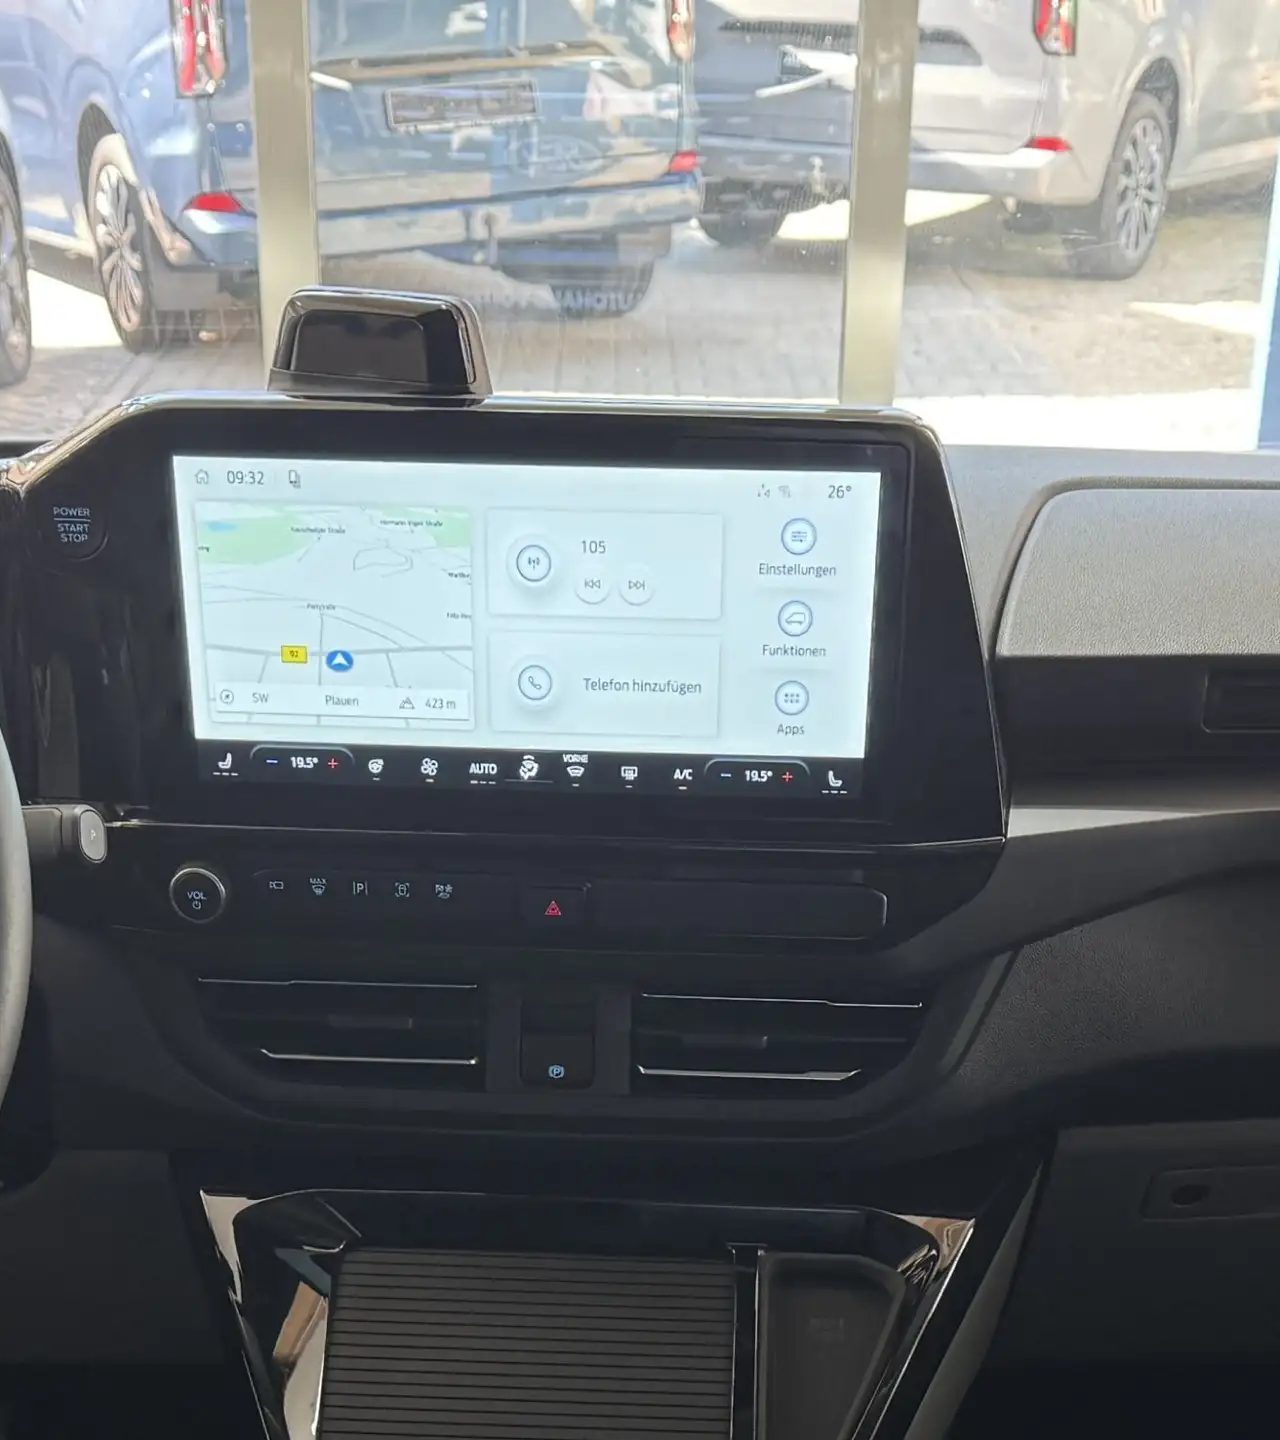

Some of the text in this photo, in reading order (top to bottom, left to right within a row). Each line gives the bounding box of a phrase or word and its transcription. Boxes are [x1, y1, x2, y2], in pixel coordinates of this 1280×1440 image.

[227, 470, 265, 485] 09:32
[827, 485, 852, 499] 26°
[53, 506, 91, 517] POWER
[57, 523, 90, 533] START
[60, 533, 88, 543] STOP
[581, 540, 607, 555] 105
[758, 562, 837, 578] Einstellungen
[762, 644, 827, 659] Funktionen
[583, 677, 702, 696] Telefon hinzufügen
[252, 692, 269, 704] SW
[325, 694, 359, 707] Plauen
[425, 697, 443, 709] 423
[777, 723, 805, 737] Apps
[469, 763, 498, 775] AUTO
[673, 768, 693, 781] A/C
[187, 890, 207, 901] VOL
